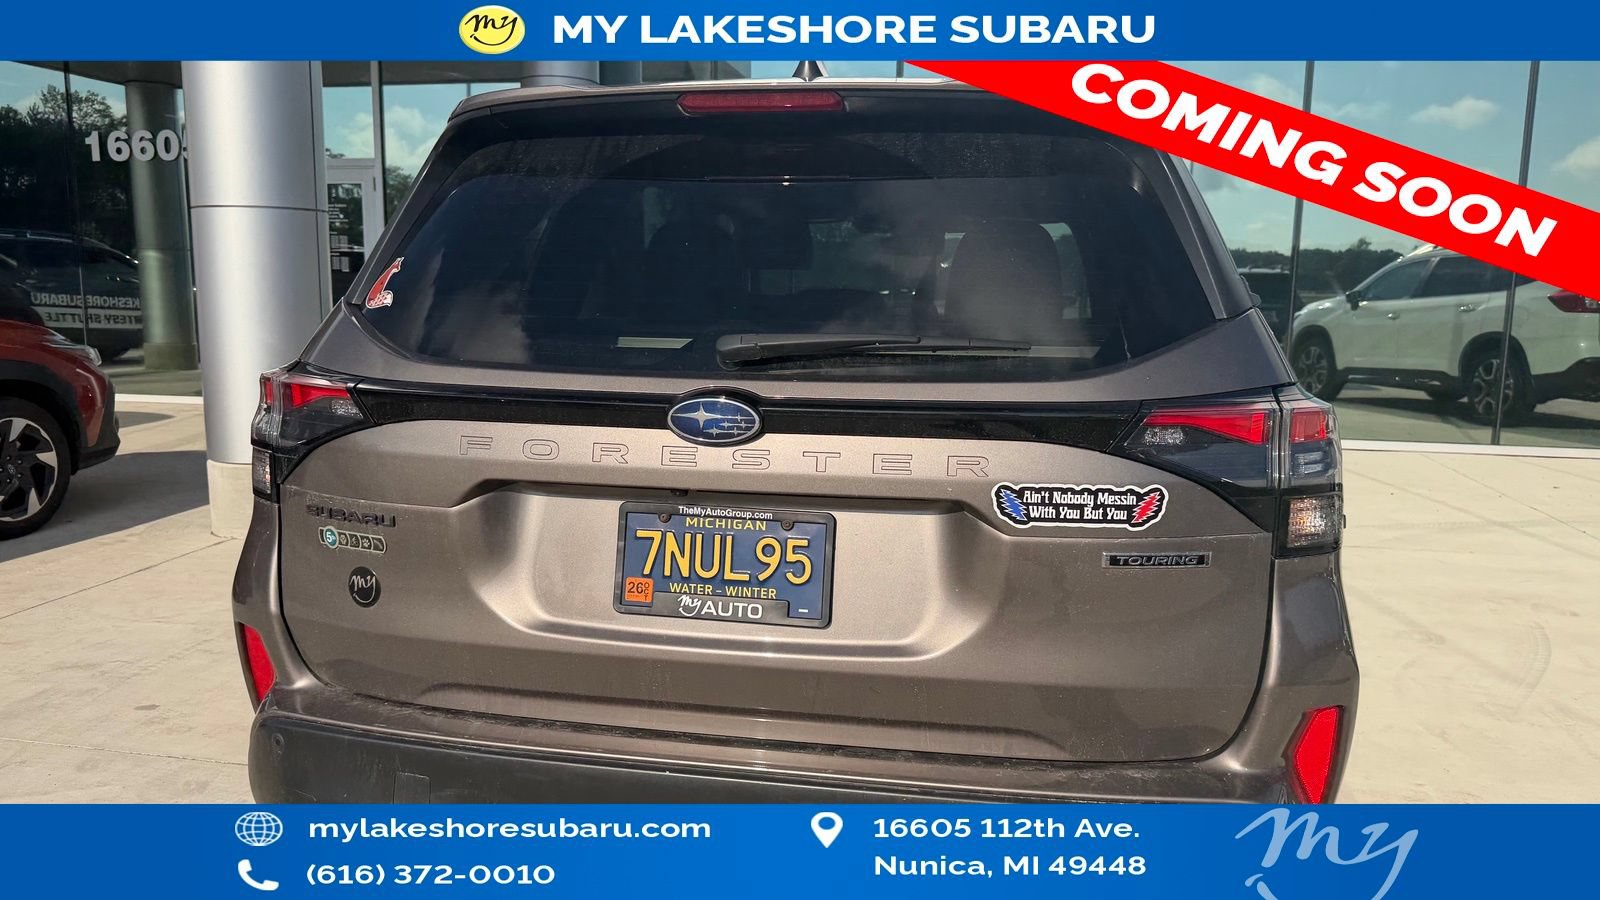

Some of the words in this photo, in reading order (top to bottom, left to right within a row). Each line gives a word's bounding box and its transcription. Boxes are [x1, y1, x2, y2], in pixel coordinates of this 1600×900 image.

[459, 435, 990, 478] FORESTER
[1022, 490, 1050, 504] Ain't
[1052, 491, 1094, 507] Nobody
[1097, 492, 1137, 505] Messin
[306, 504, 397, 528] SUBARU
[678, 505, 773, 520] TheMyAutoGroup.com
[1029, 505, 1057, 519] With
[1059, 507, 1080, 520] You
[1084, 506, 1104, 520] But
[1106, 508, 1128, 520] You
[685, 517, 767, 531] MICHIGAN
[635, 529, 812, 585] 7NUL95
[1115, 555, 1200, 566] TOURING
[627, 581, 644, 595] 26
[669, 582, 713, 595] WATER
[725, 585, 777, 599] WINTER
[701, 600, 763, 619] AUTO
